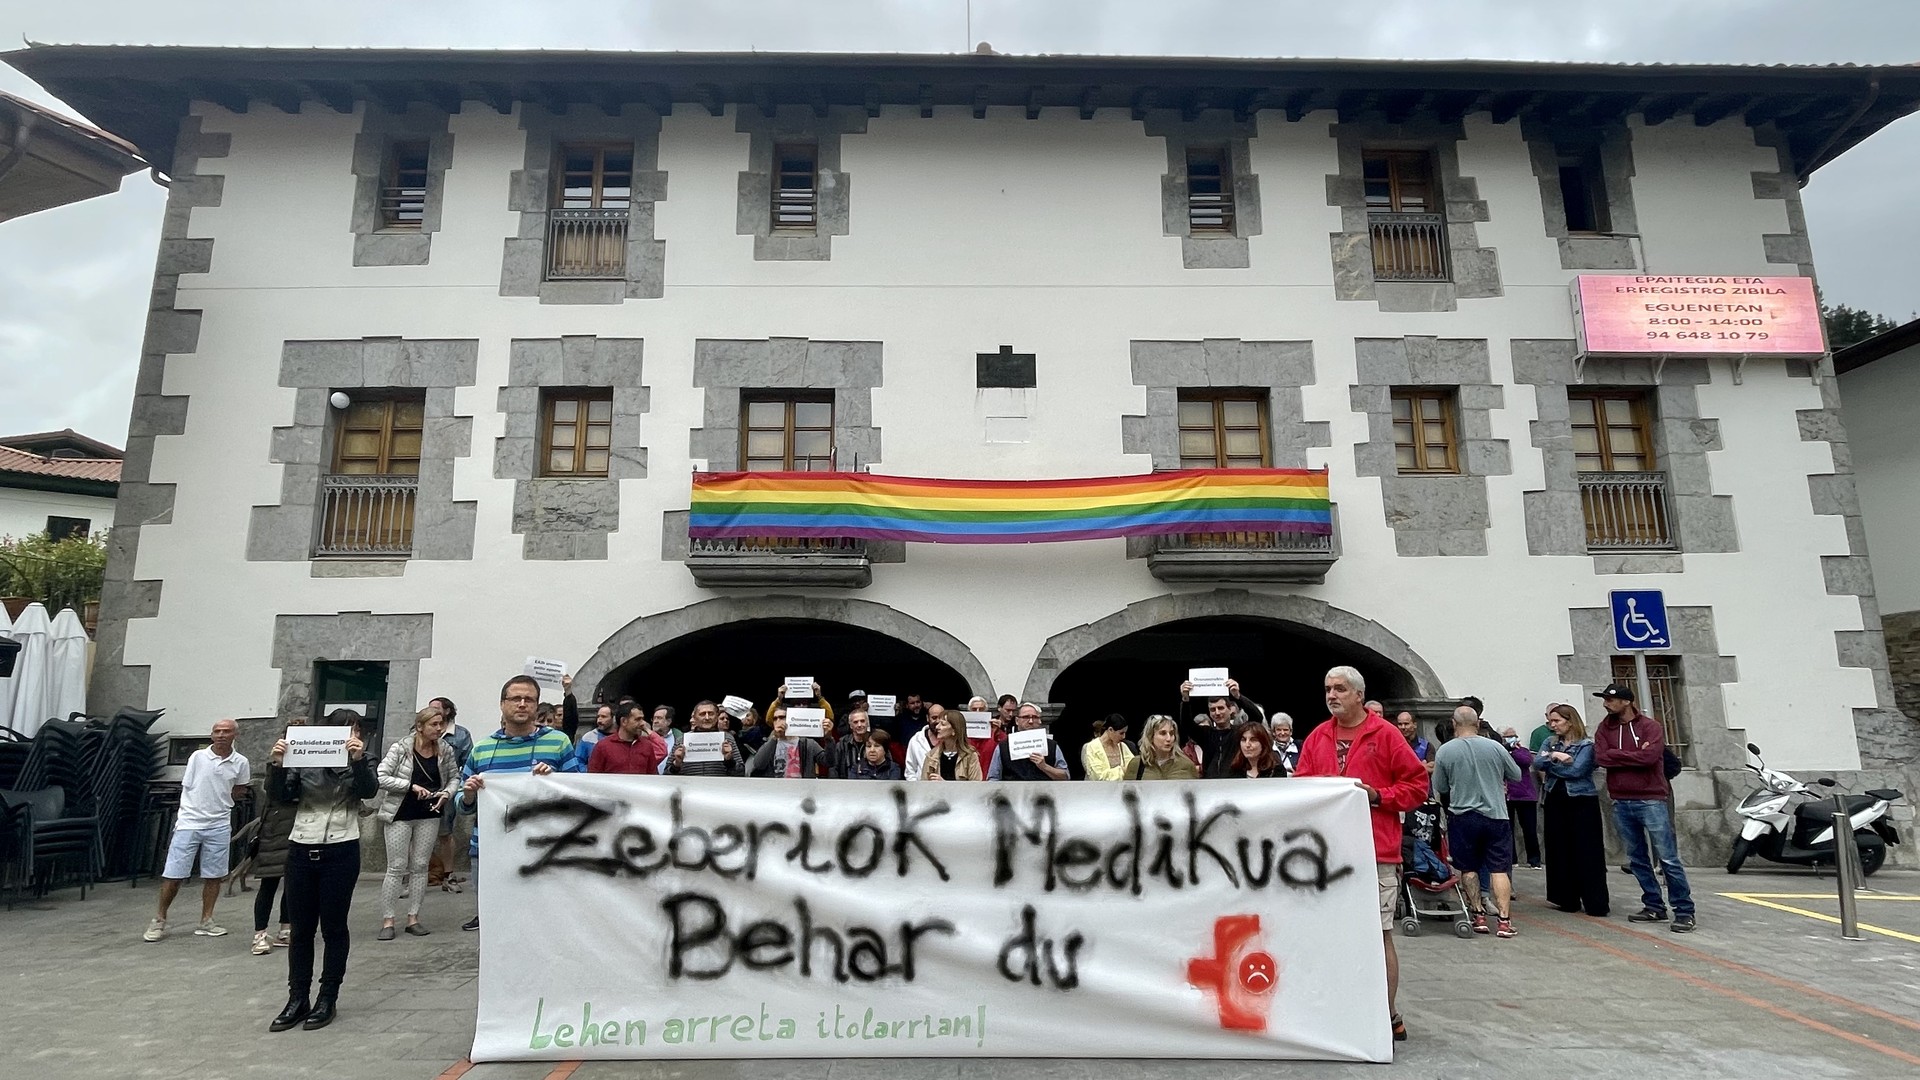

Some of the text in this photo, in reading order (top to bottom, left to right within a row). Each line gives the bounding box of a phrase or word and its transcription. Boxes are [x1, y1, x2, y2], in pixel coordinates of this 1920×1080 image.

[1635, 276, 1764, 285] EPAITEGIA ETA
[1615, 286, 1787, 295] ERREGISTRO ZIBILA
[1644, 303, 1763, 313] EGUENETAN
[1708, 318, 1763, 326] 14:00
[1646, 331, 1769, 340] 94 648 10 79
[660, 891, 1084, 991] Behar du
[529, 996, 987, 1050] Lehen arreta itolarrian!
